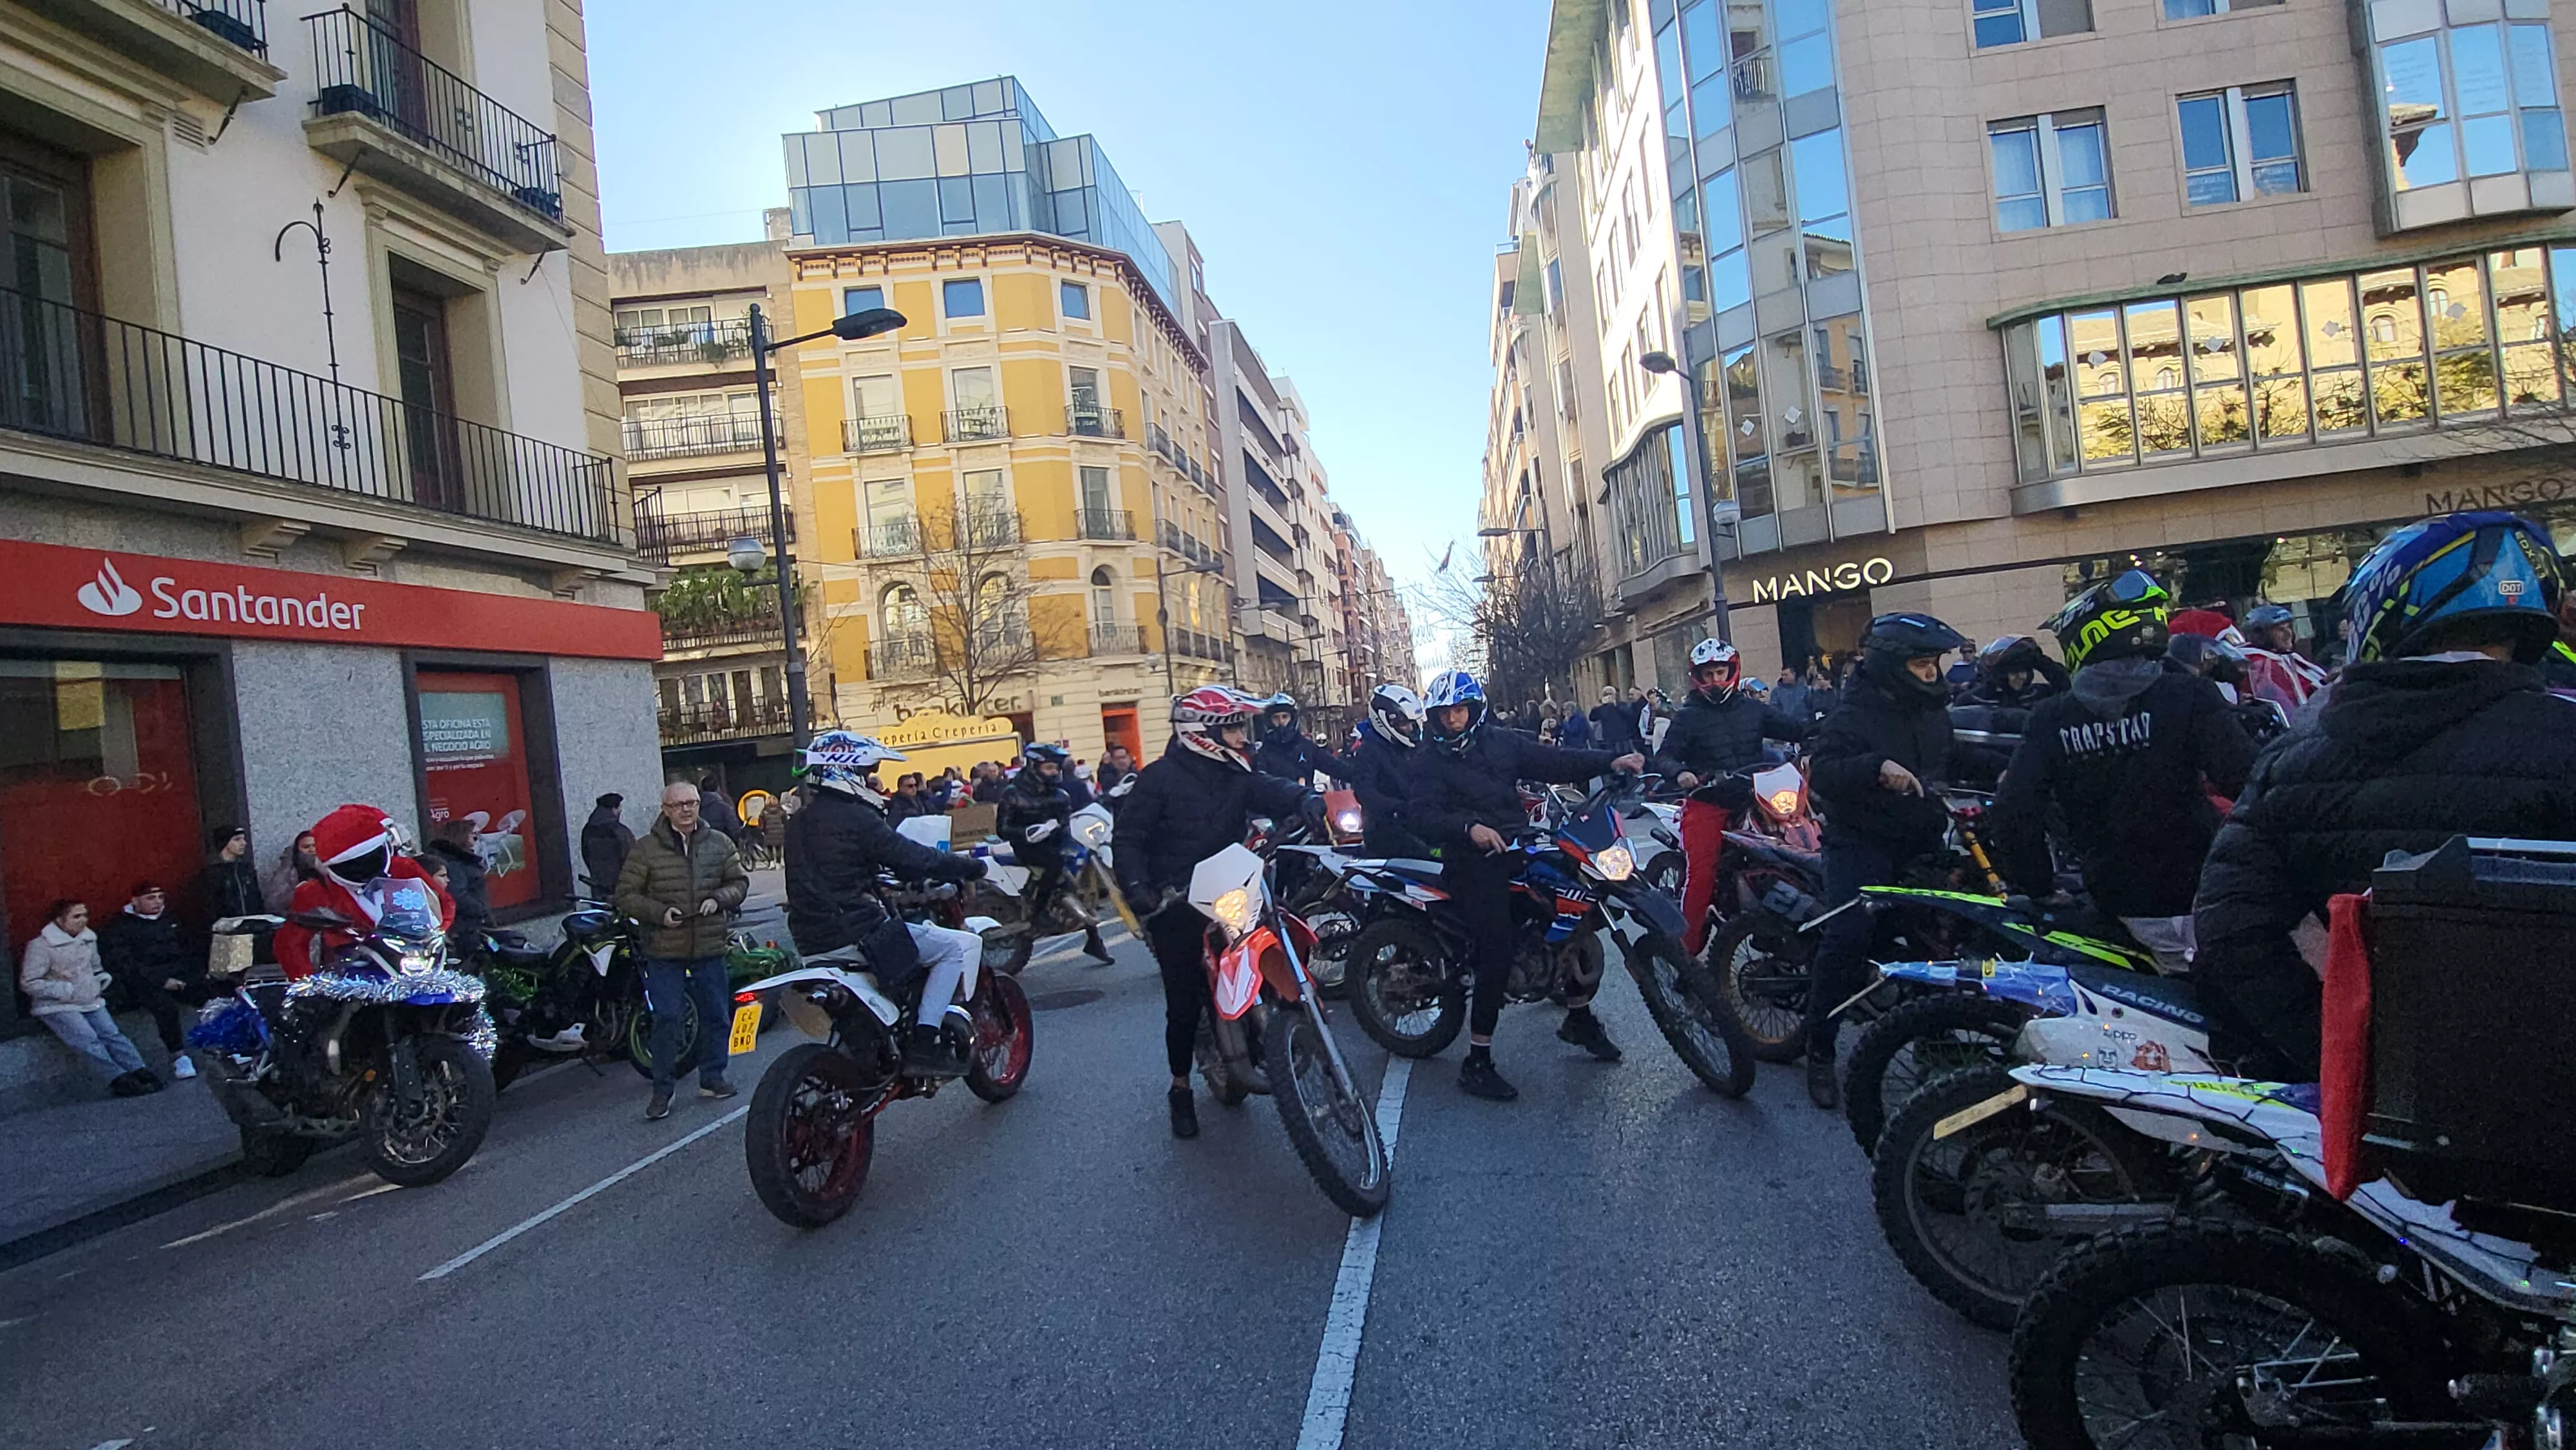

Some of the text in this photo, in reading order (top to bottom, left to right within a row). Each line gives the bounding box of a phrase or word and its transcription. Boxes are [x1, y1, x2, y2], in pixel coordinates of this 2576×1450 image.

[2426, 478, 2564, 514] MANGO
[1752, 558, 1893, 603] MANGO
[2501, 583, 2521, 592] DOT
[151, 577, 365, 630] Santander
[422, 719, 438, 730] STA
[422, 730, 480, 740] SPECIALIZADA
[431, 741, 468, 752] NEGOCIO
[2101, 983, 2205, 1024] RACING
